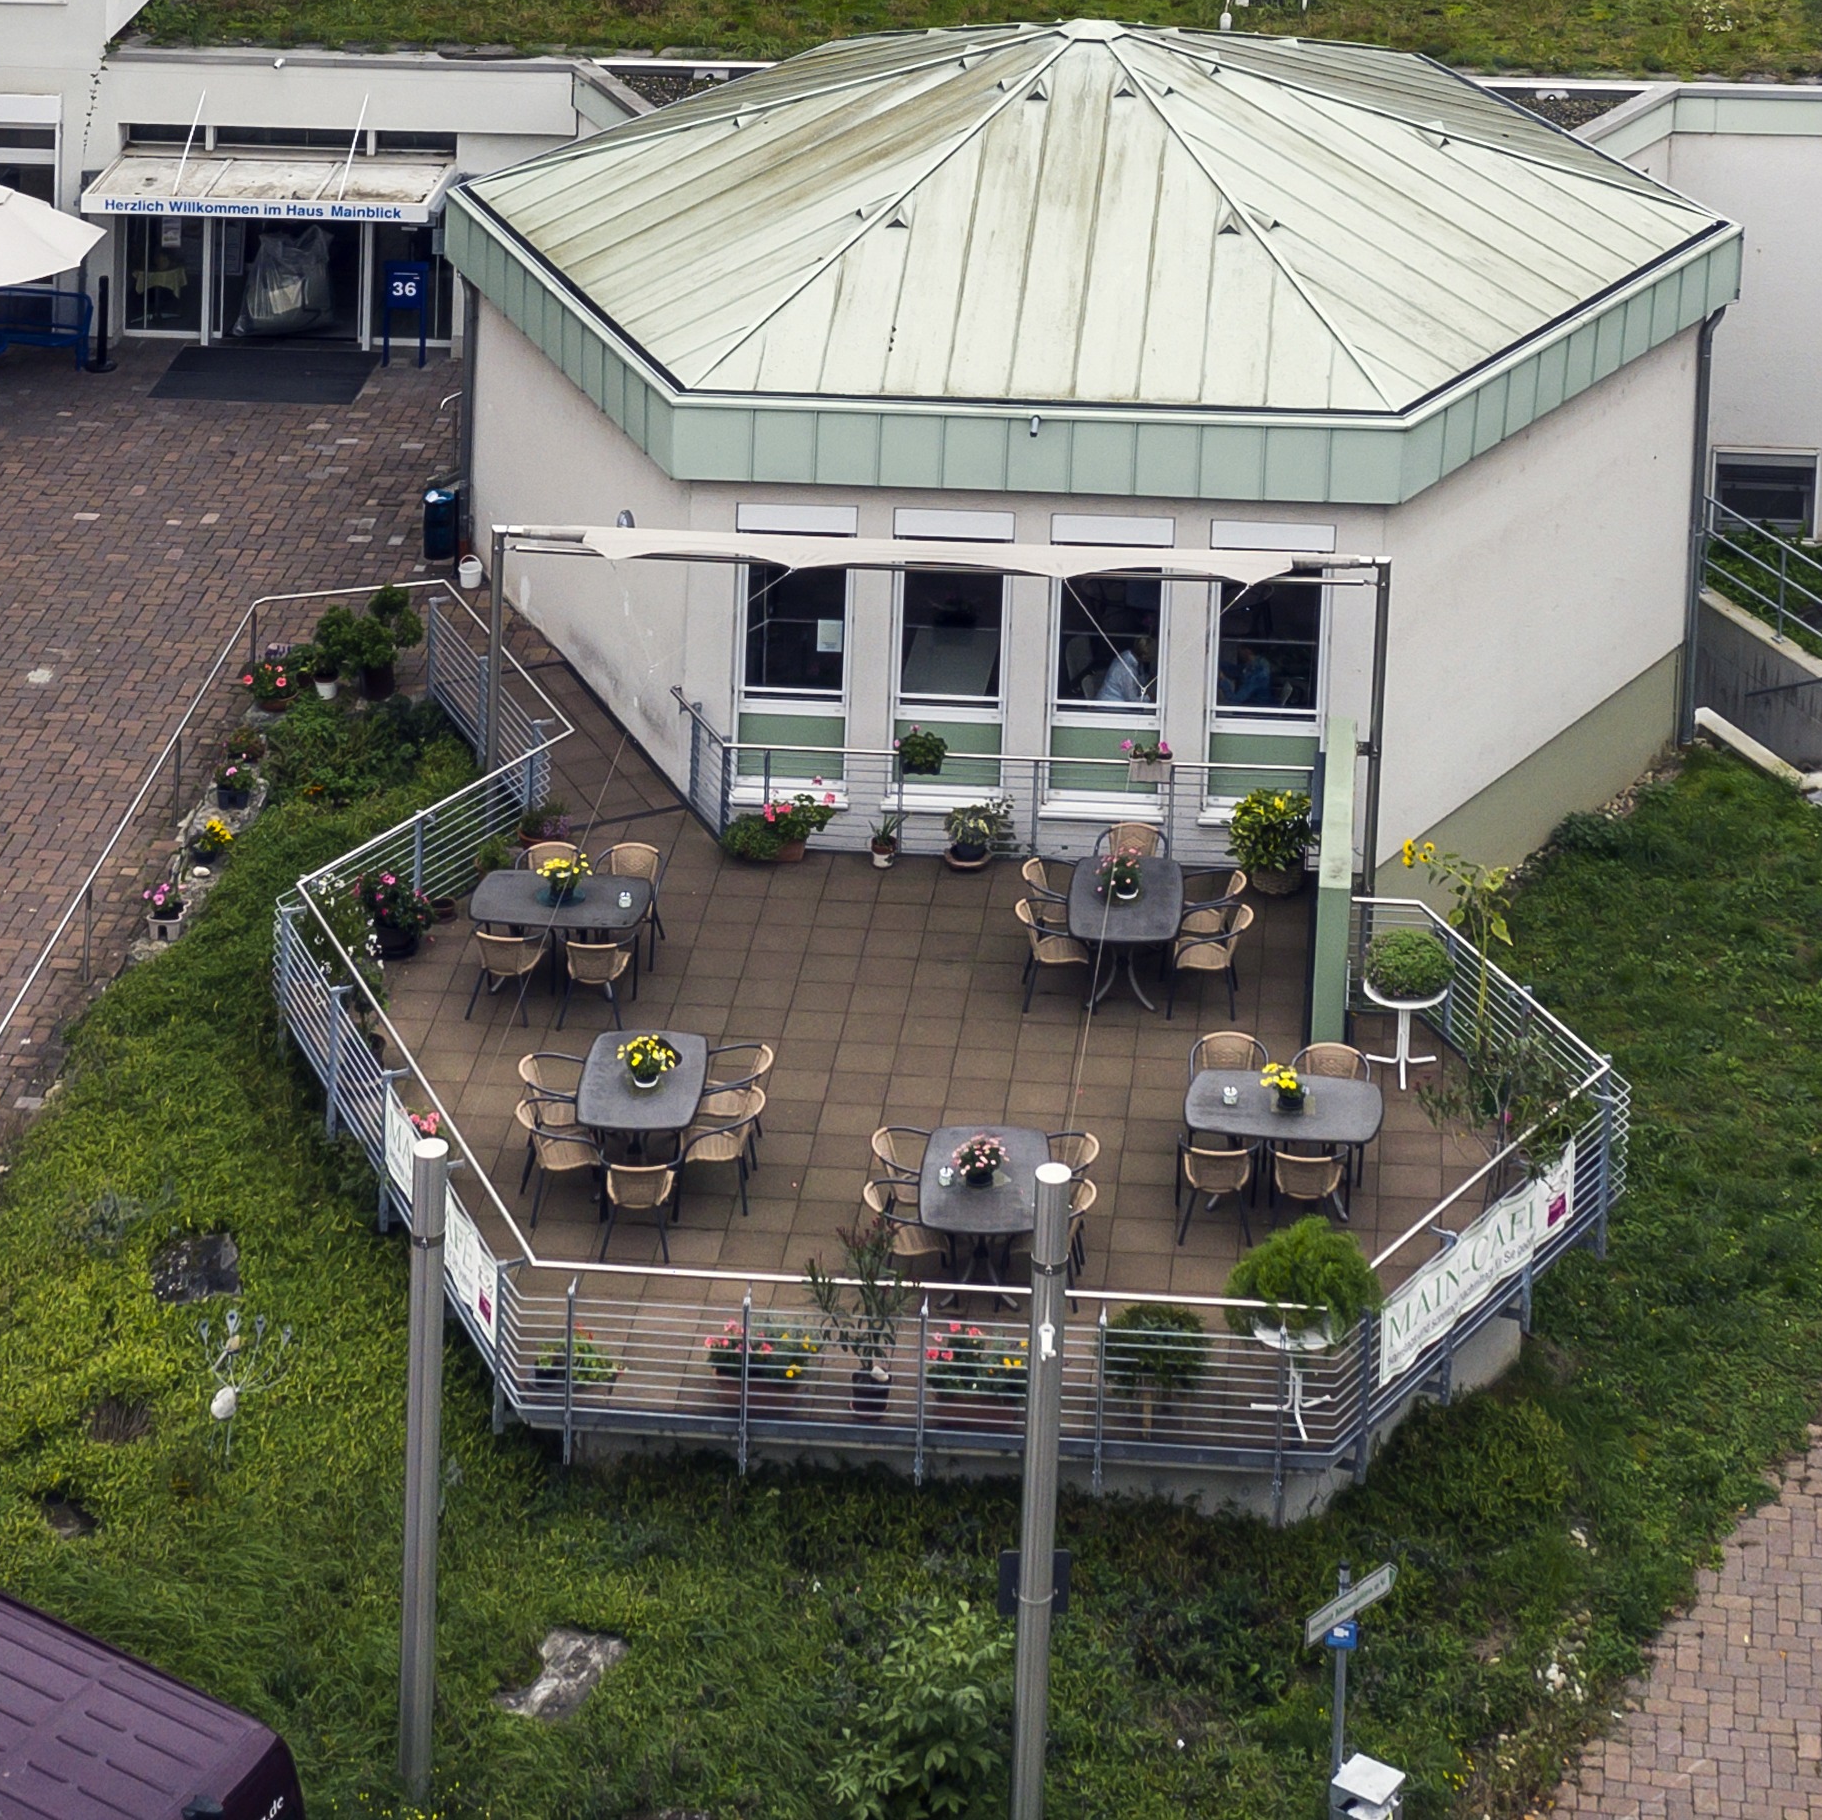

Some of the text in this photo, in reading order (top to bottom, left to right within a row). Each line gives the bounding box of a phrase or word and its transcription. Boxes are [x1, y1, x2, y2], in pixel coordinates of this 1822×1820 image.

[104, 198, 402, 220] Herzlich Willkommen im Haus Mainblick
[392, 281, 417, 297] 36
